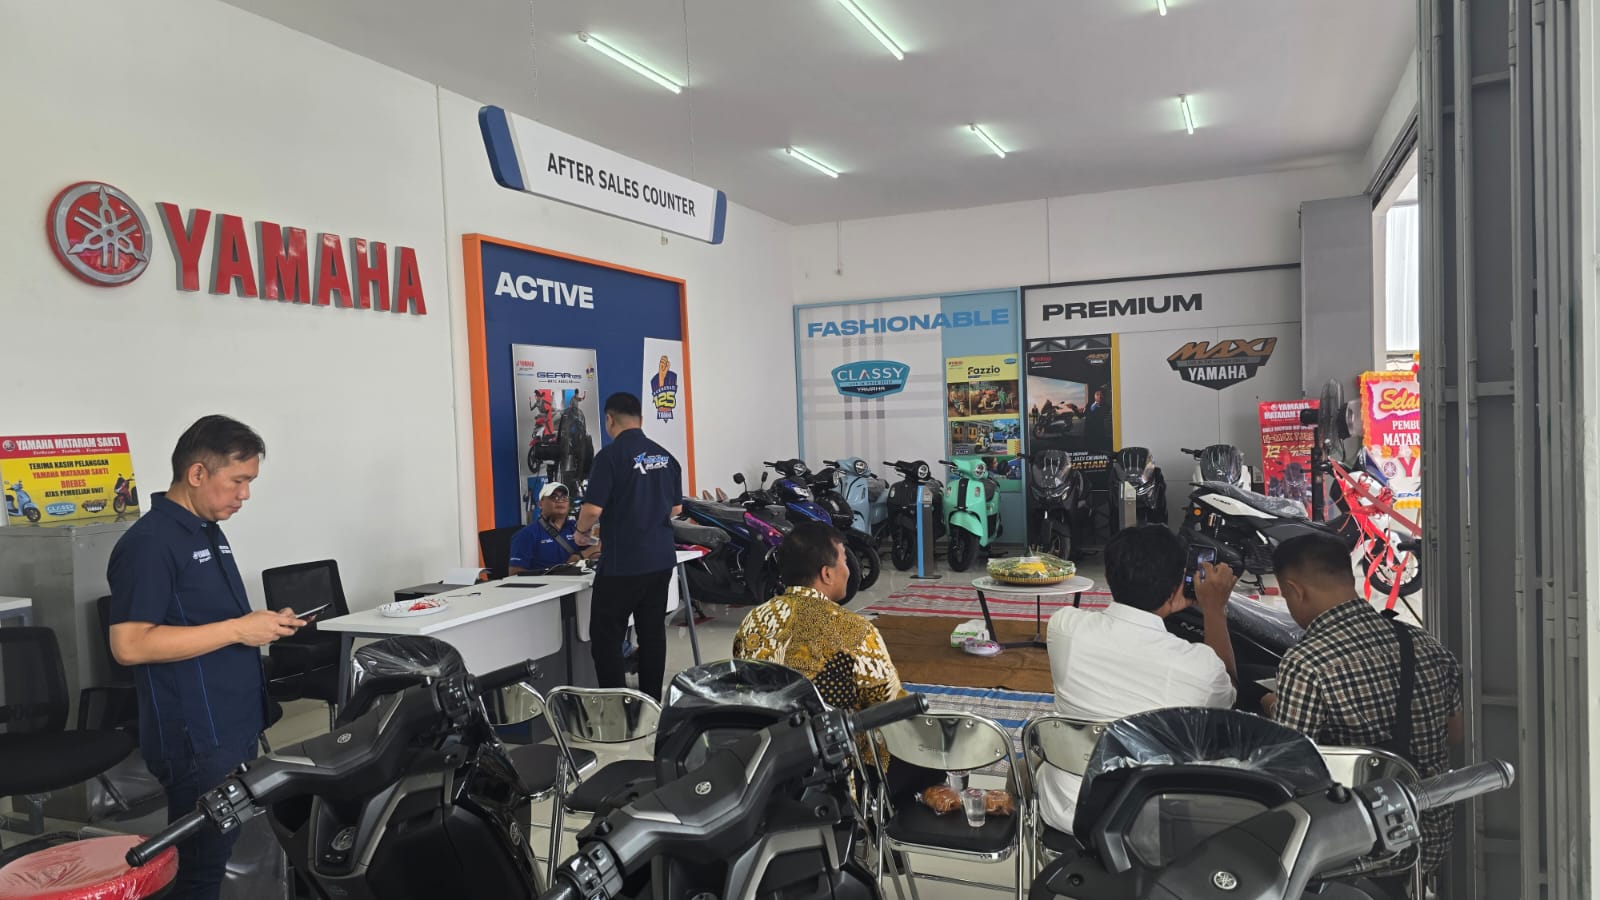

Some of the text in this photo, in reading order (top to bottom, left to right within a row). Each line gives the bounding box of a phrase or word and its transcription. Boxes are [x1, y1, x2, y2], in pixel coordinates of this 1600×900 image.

[547, 152, 696, 217] AFTER SALES COUNTER
[155, 201, 428, 315] YAMAHA
[494, 271, 594, 310] ACTIVE
[1042, 293, 1203, 321] PREMIUM
[807, 308, 1009, 338] FASHIONABLE
[1167, 337, 1277, 361] MAXI
[836, 367, 905, 381] CLASSY
[967, 365, 1001, 375] Fazzio
[1188, 366, 1248, 382] YAMAHA
[653, 391, 676, 408] 125
[16, 437, 121, 450] YAMAHA MATARAM SAKTI
[29, 459, 109, 470] TERIMA KASIH PELANGGAN
[91, 468, 109, 476] SAKTI
